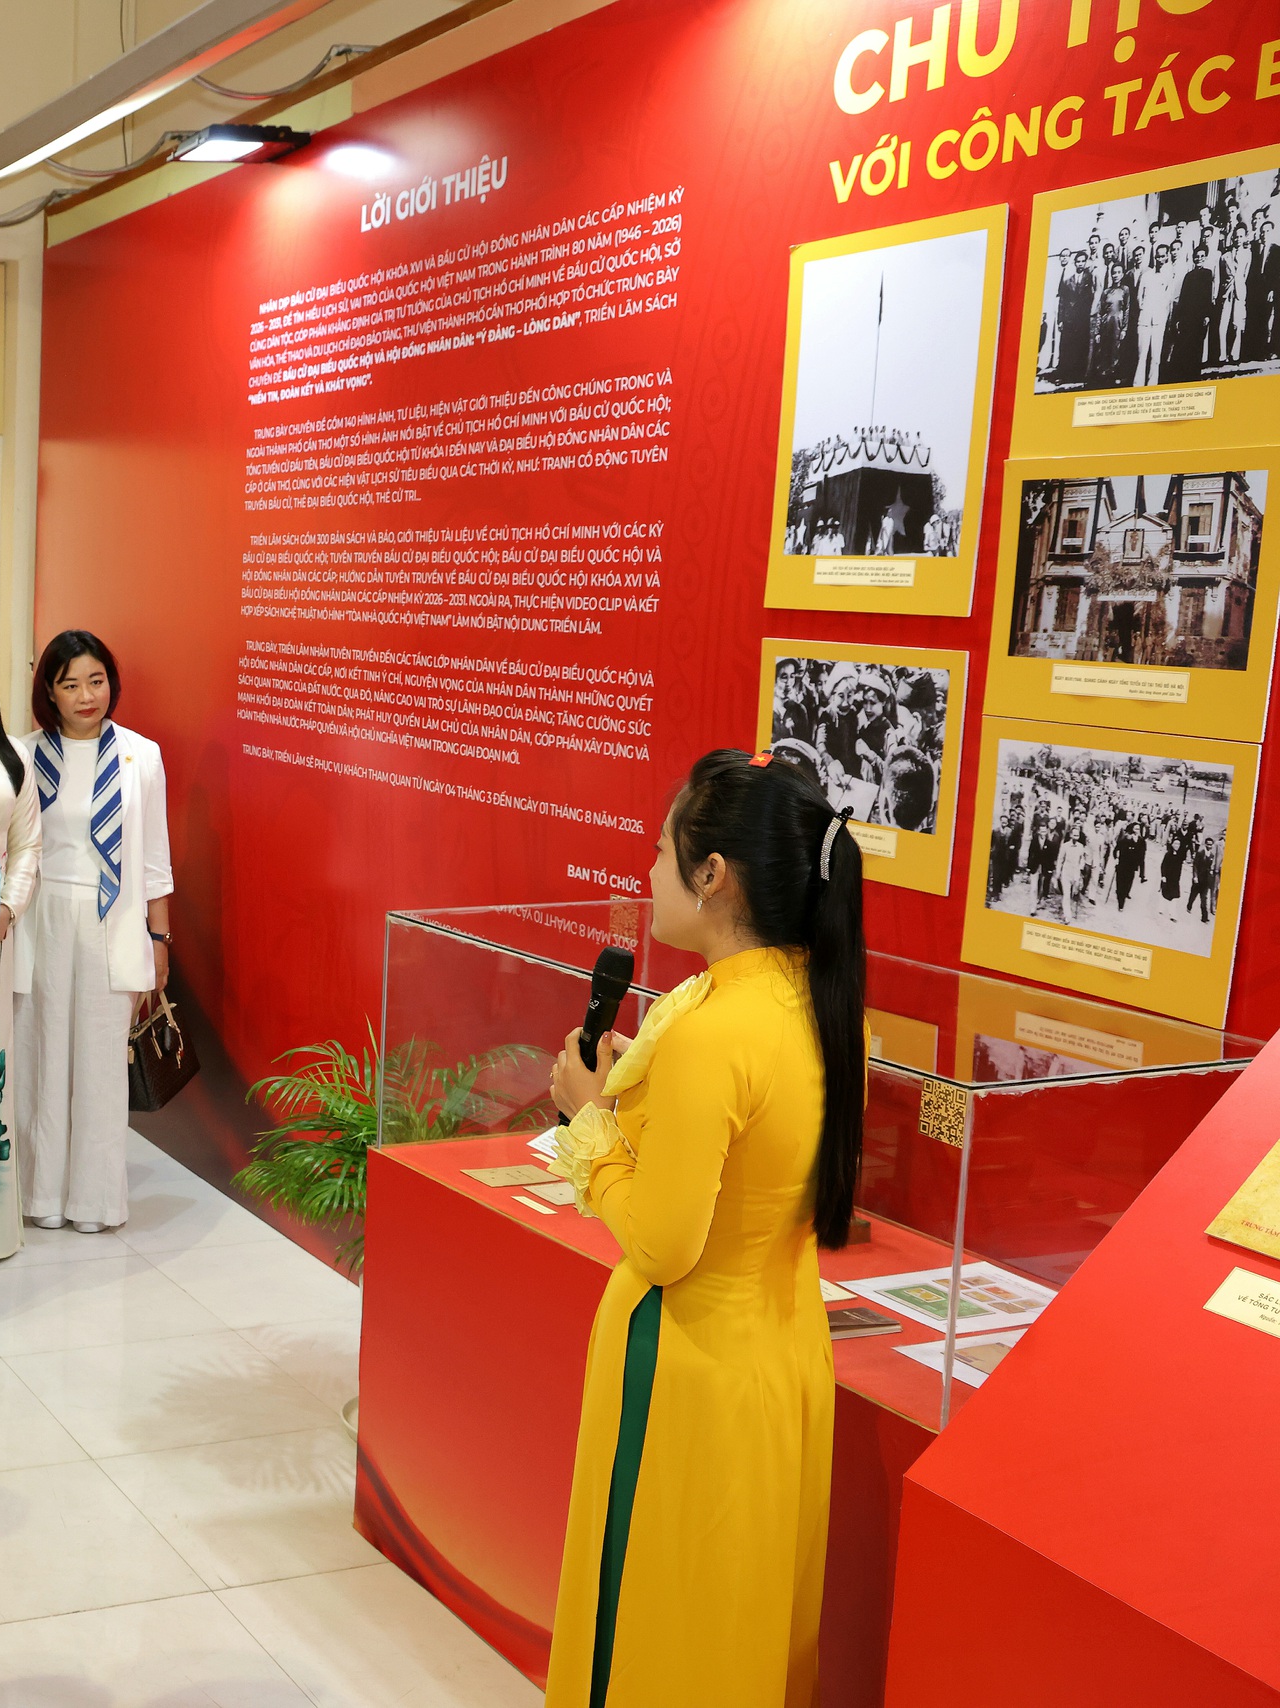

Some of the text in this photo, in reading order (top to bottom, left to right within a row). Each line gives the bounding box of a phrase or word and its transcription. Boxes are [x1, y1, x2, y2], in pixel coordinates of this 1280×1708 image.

[829, 133, 912, 204] VỚI
[925, 95, 1085, 180] CÔNG
[1104, 52, 1236, 136] TÁC
[360, 154, 508, 233] LỜI GIỚI THIỆU
[552, 217, 575, 237] DÂN
[577, 210, 600, 230] CÁC
[627, 193, 666, 217] NHIỆM
[668, 185, 685, 206] KỲ
[587, 232, 612, 251] NĂM
[615, 224, 642, 248] (1946
[652, 213, 682, 236] 2026)
[616, 272, 654, 293] TRƯNG
[656, 265, 680, 285] BÀY
[618, 299, 643, 317] LÃM
[645, 293, 677, 312] SÁCH
[573, 367, 673, 397] CHÚNG TRONG VÀ
[589, 424, 619, 443] NHÂN
[621, 422, 645, 440] DÂN
[646, 419, 670, 438] CÁC
[595, 449, 628, 469] ĐỘNG
[630, 445, 668, 463] TUYÊN
[551, 523, 570, 540] CHÍ
[572, 525, 600, 539] MINH
[623, 521, 647, 538] CÁC
[649, 520, 664, 537] KỲ
[540, 550, 558, 566] ĐẠI
[622, 546, 643, 565] HỘI
[646, 545, 662, 562] VÀ
[569, 570, 588, 589] HỘI
[590, 570, 622, 587] KHÓA
[624, 573, 642, 587] XVI
[645, 570, 661, 587] VÀ
[565, 597, 598, 611] VIDEO
[598, 597, 622, 611] CLIP
[623, 595, 638, 612] VÀ
[521, 618, 548, 632] DUNG
[618, 668, 638, 688] HỘI
[639, 670, 654, 687] VÀ
[515, 683, 536, 699] DÂN
[538, 685, 573, 703] THÀNH
[556, 710, 584, 728] TĂNG
[584, 737, 603, 754] XÂY
[603, 742, 634, 759] DỰNG
[635, 744, 650, 761] VÀ
[513, 796, 539, 812] NGÀY
[539, 801, 549, 815] 01
[550, 803, 583, 822] THÁNG
[584, 810, 592, 824] 8
[593, 810, 617, 829] NĂM
[567, 864, 642, 894] BAN TỔ CHỨC
